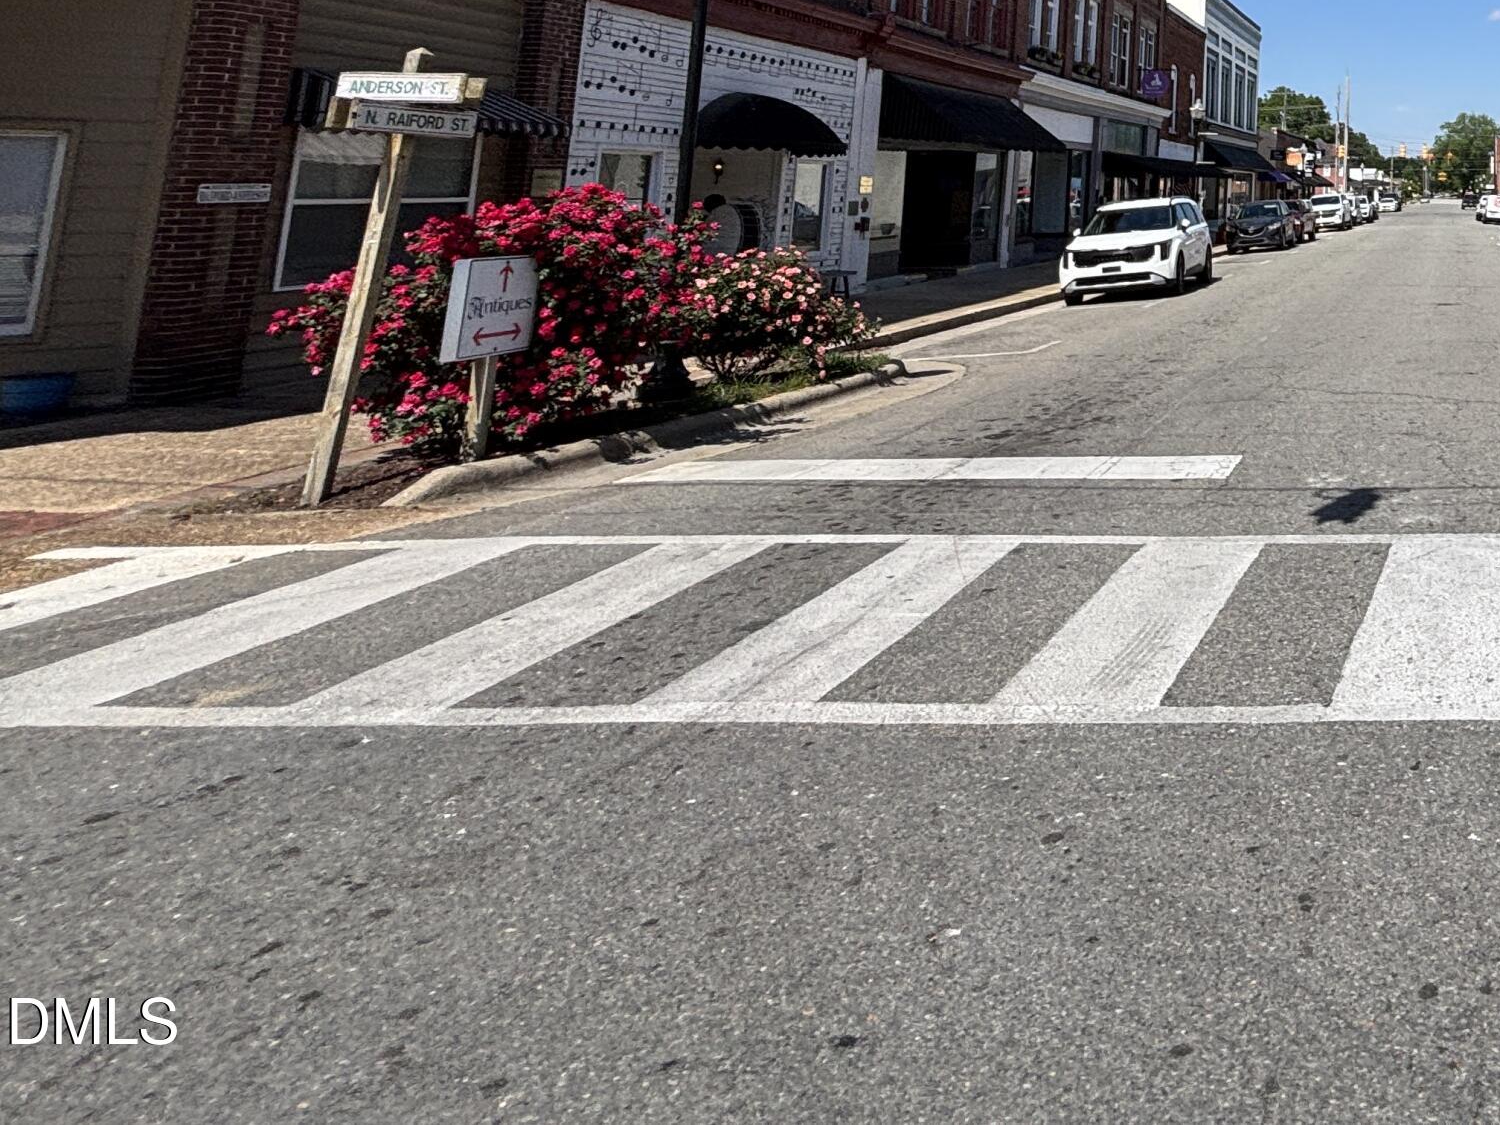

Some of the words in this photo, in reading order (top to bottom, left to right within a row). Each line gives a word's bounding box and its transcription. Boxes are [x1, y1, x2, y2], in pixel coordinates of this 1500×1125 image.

[349, 79, 423, 95] ANDERSON
[430, 80, 449, 95] ST.
[387, 111, 445, 130] RAIFORD
[467, 296, 533, 321] Antiques
